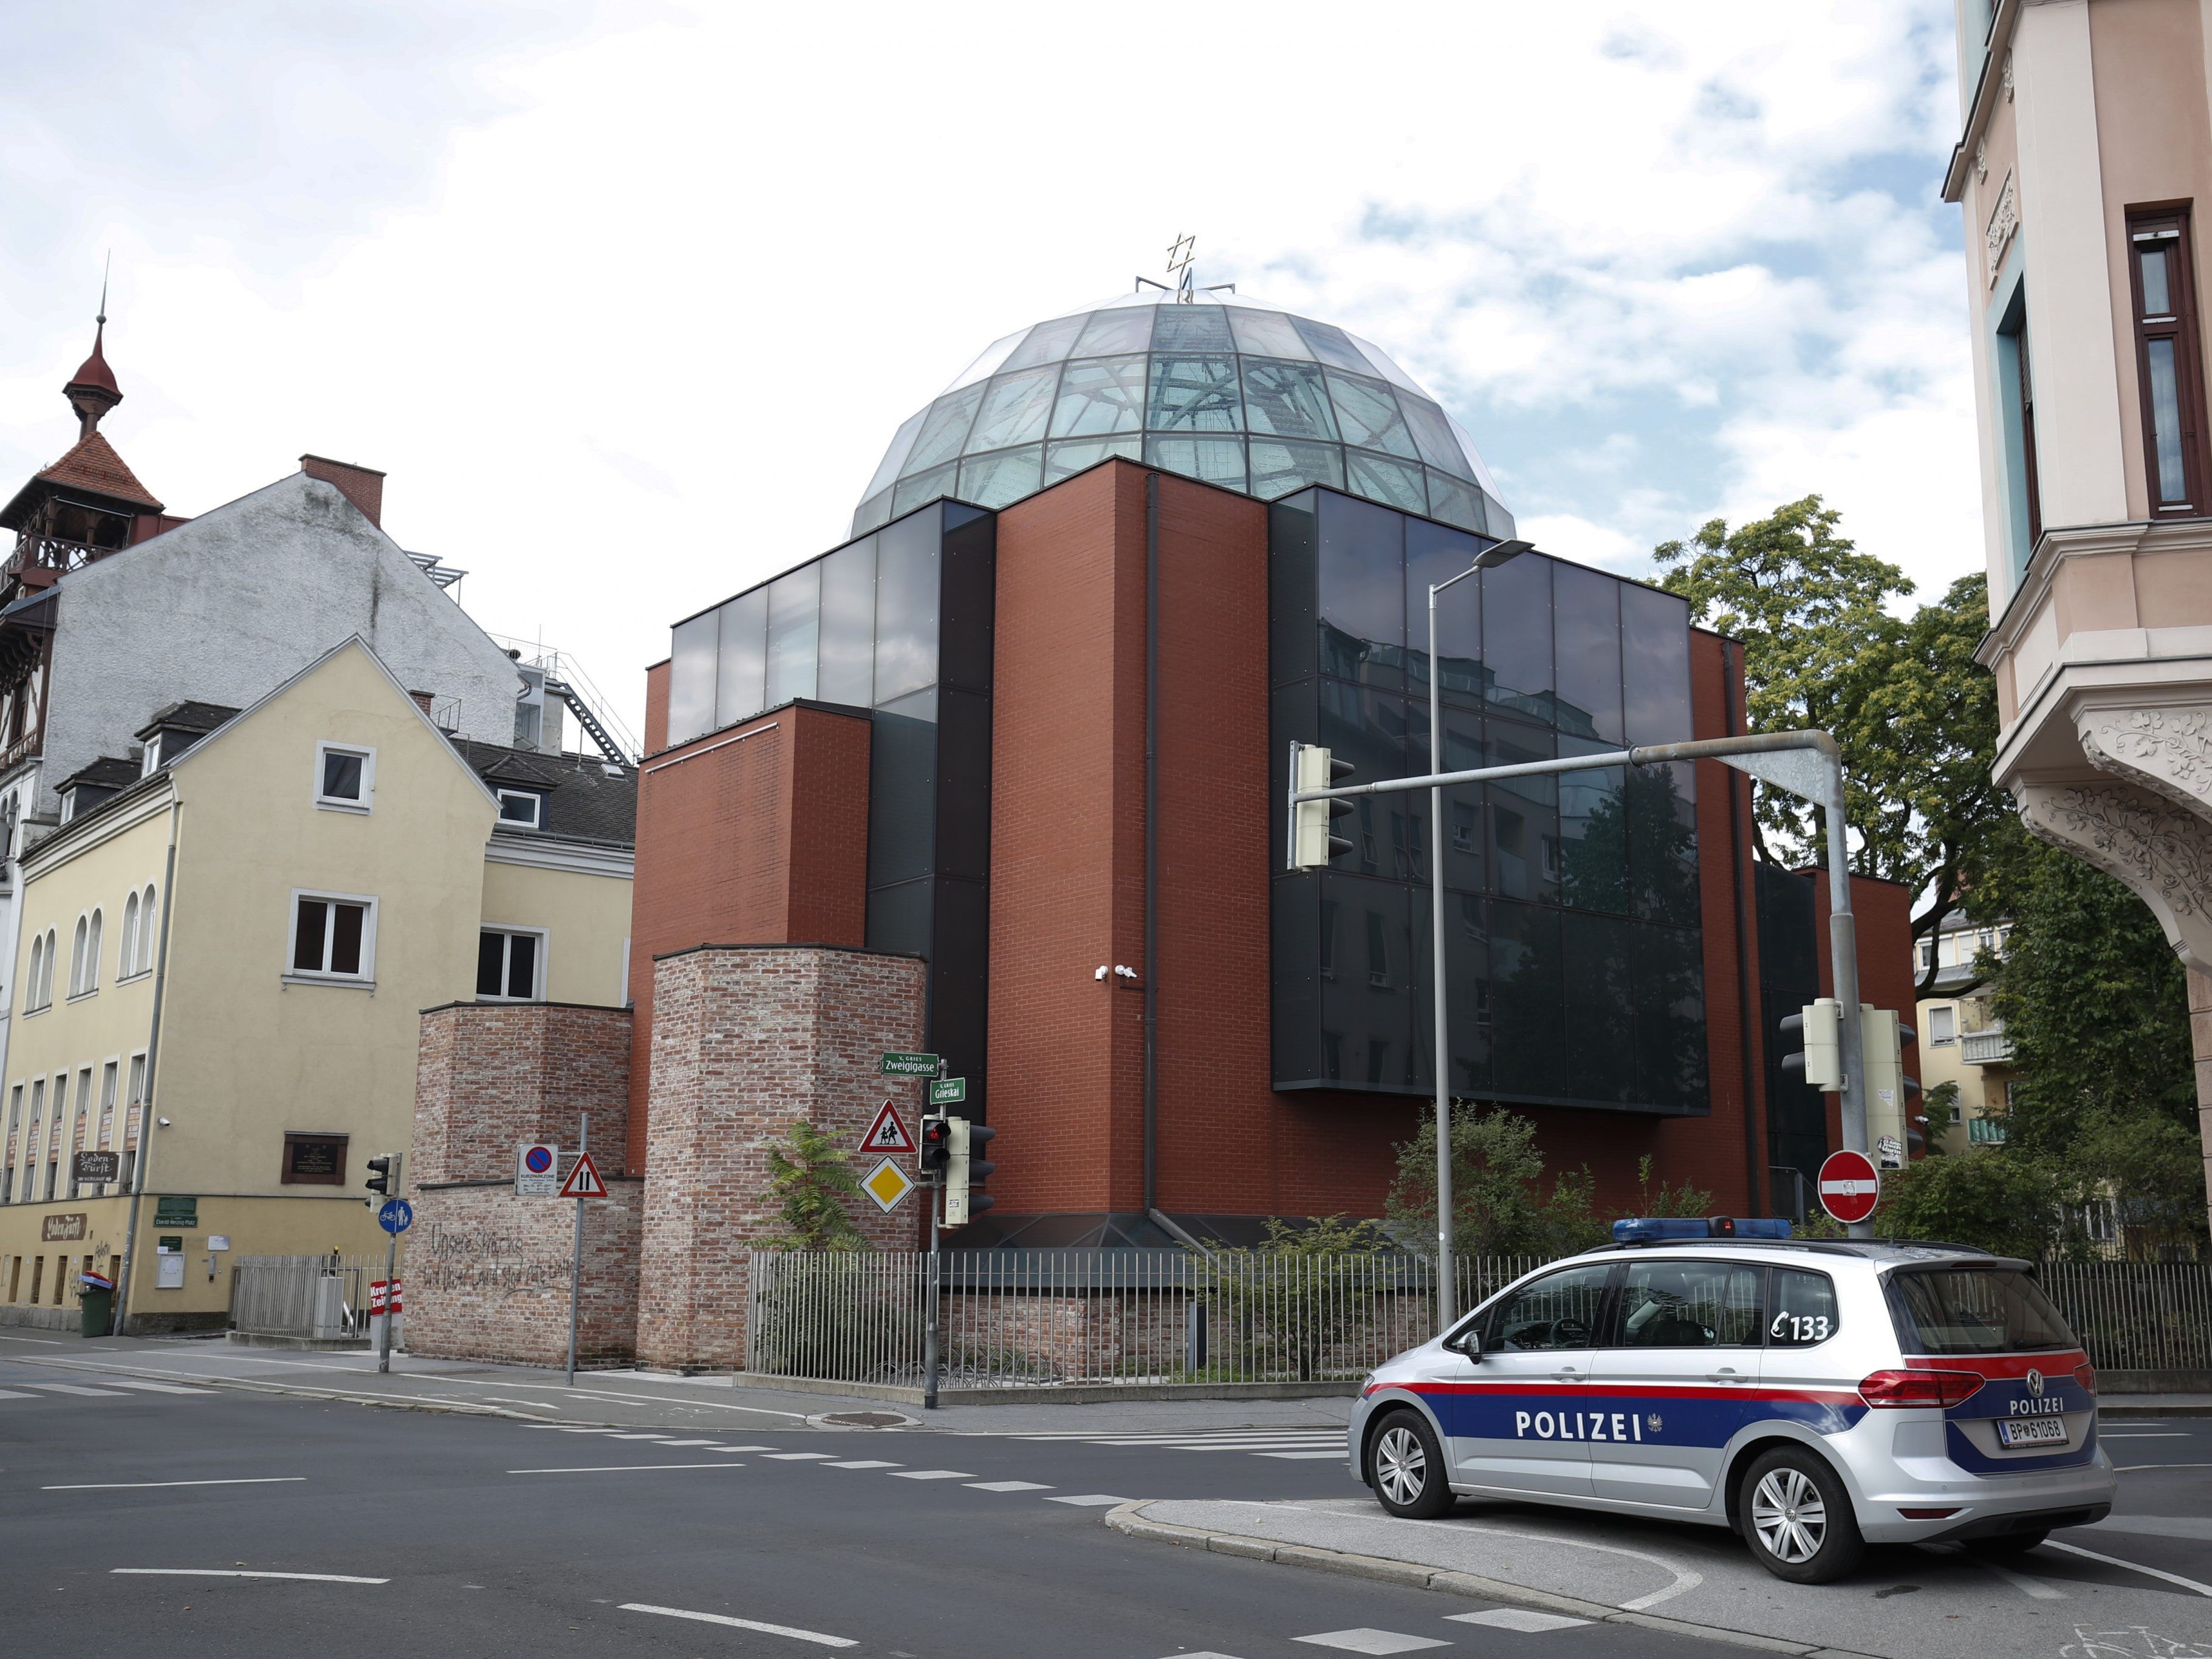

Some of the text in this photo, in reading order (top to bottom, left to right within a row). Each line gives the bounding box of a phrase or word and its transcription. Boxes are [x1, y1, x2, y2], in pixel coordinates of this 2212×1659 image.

[886, 1060, 934, 1072] Zweiglgasse
[935, 1087, 959, 1098] Grieskai
[1790, 1316, 1829, 1340] 133
[2010, 1397, 2064, 1415] POLIZEI
[1516, 1411, 1641, 1441] POLIZEI
[2010, 1423, 2023, 1440] BP
[2030, 1420, 2061, 1438] 61068
